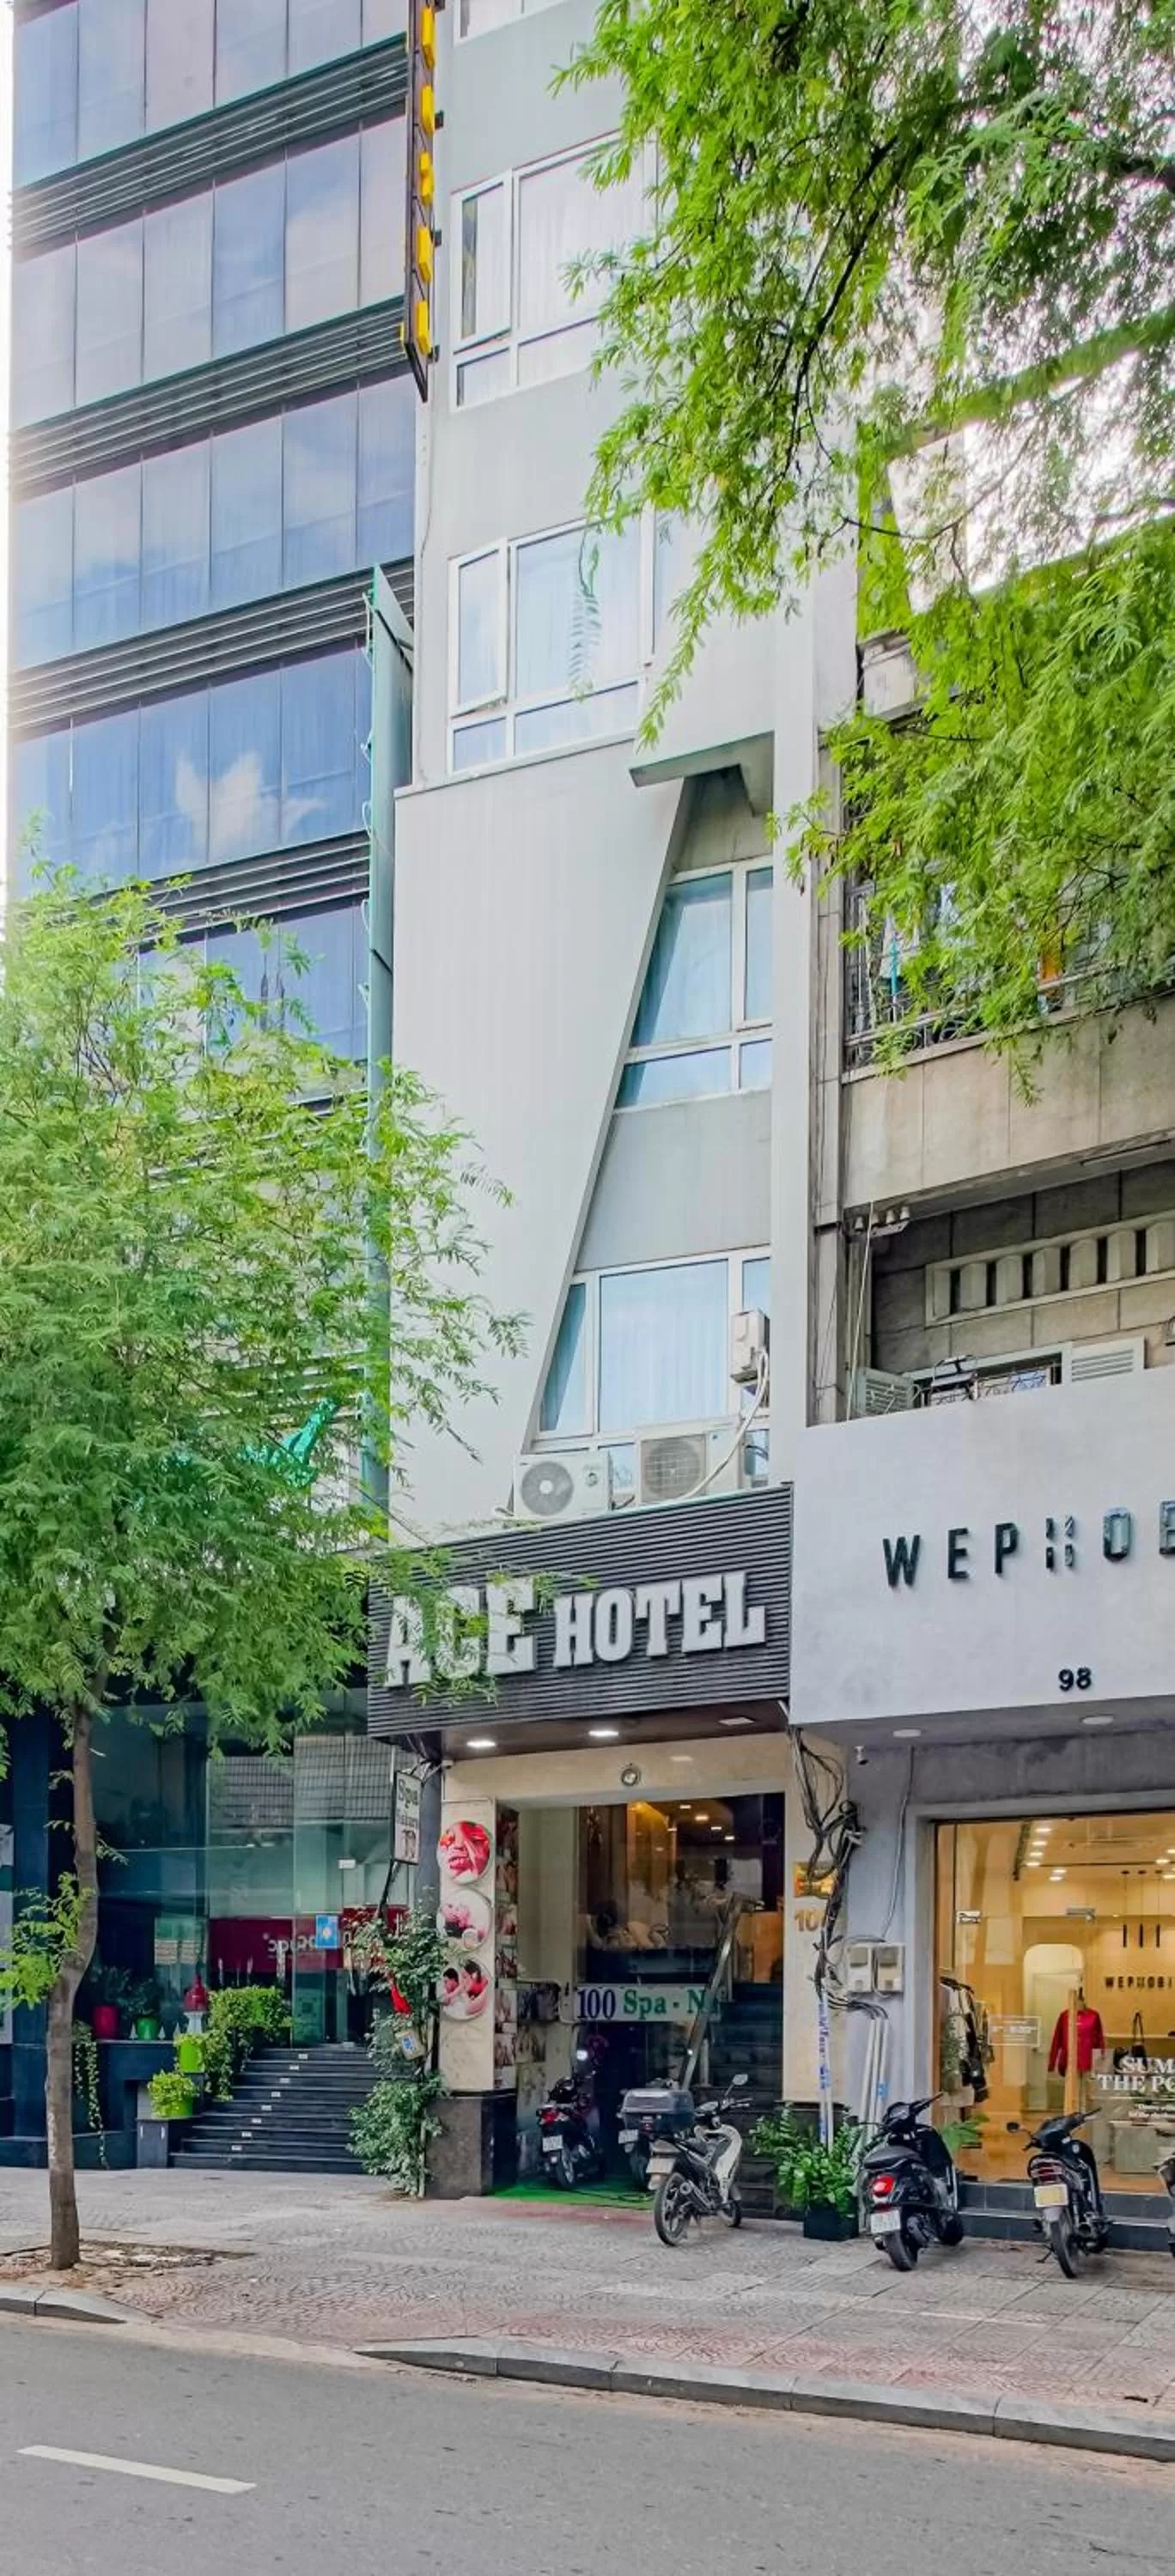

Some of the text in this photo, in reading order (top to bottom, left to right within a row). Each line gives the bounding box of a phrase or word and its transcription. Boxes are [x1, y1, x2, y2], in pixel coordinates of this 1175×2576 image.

[554, 1571, 766, 1668] HOTEL
[1057, 1667, 1093, 1691] 98
[577, 1989, 616, 2020] 100
[623, 1989, 667, 2020] Spa
